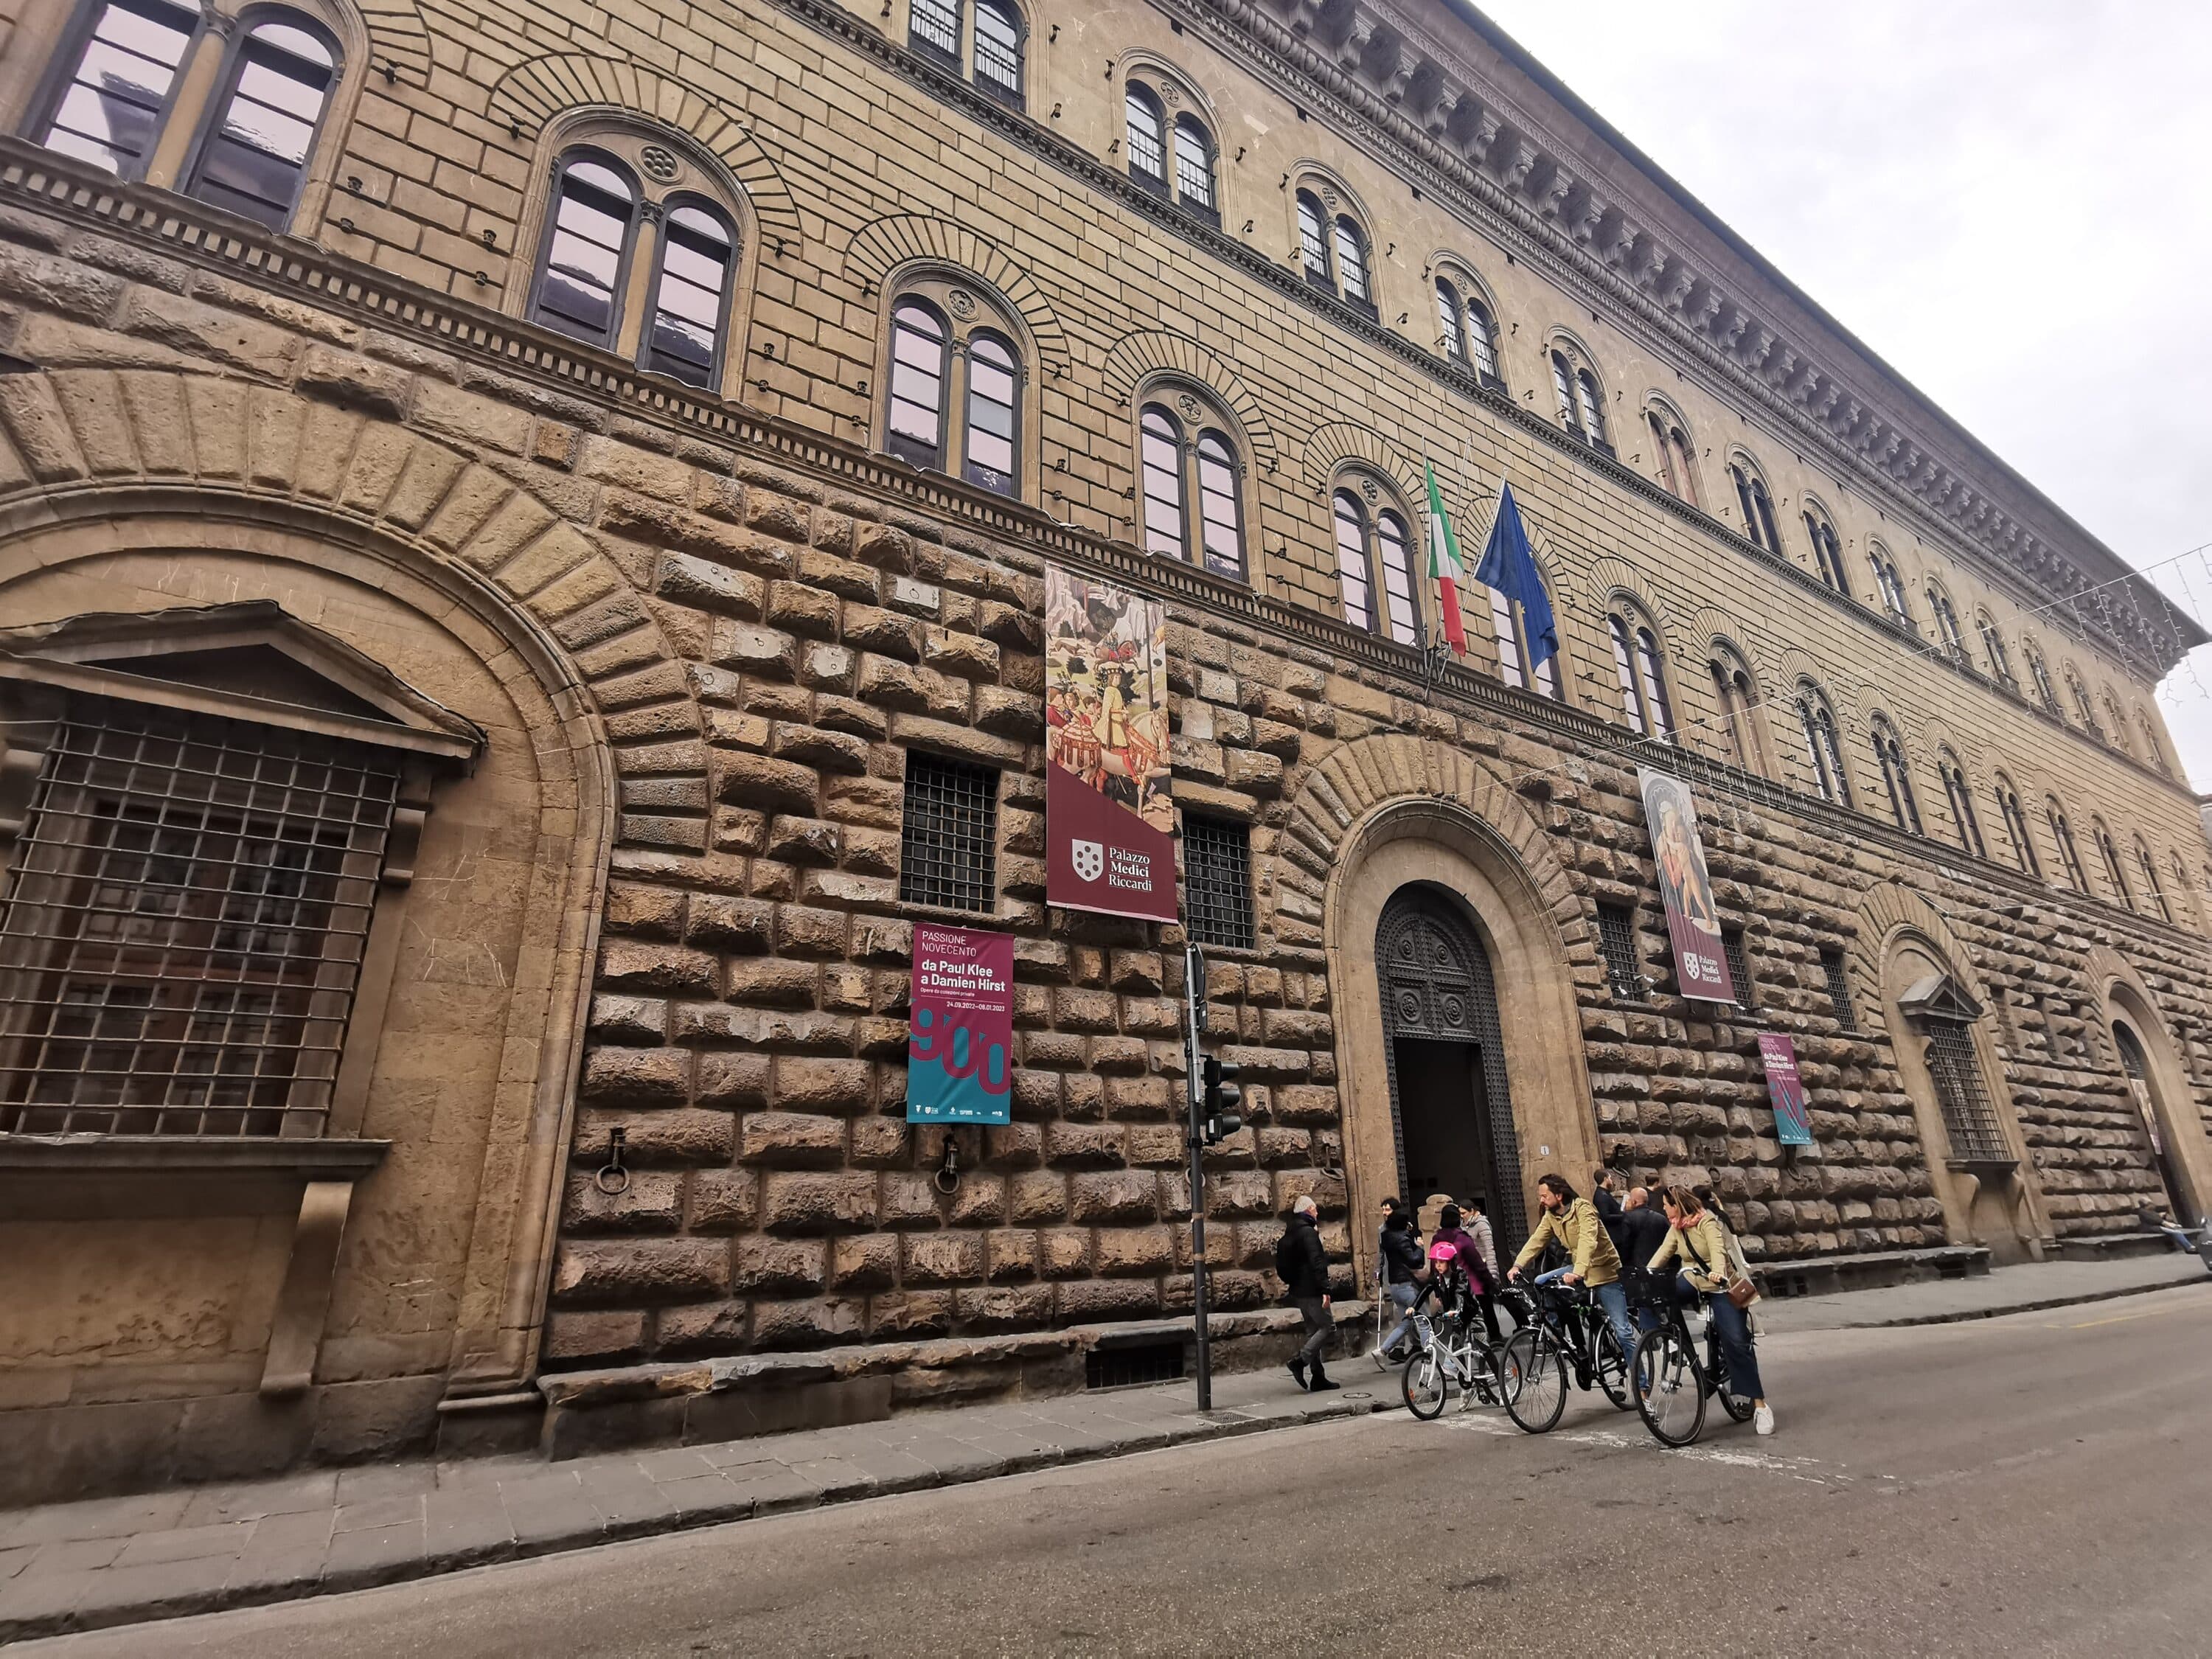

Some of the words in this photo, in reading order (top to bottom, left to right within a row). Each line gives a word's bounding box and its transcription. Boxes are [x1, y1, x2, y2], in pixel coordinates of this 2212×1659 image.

[1109, 847, 1150, 865] Palazzo
[1110, 861, 1150, 877] Medici
[1109, 874, 1152, 891] Riccardi
[922, 931, 967, 945] PASSIONE
[922, 943, 977, 957] NOVECENTO
[922, 959, 937, 971] da
[939, 961, 965, 974] Paul
[967, 964, 993, 977] Klee
[920, 975, 928, 984] a
[931, 973, 975, 990] Damien
[978, 978, 1006, 992] Hirst
